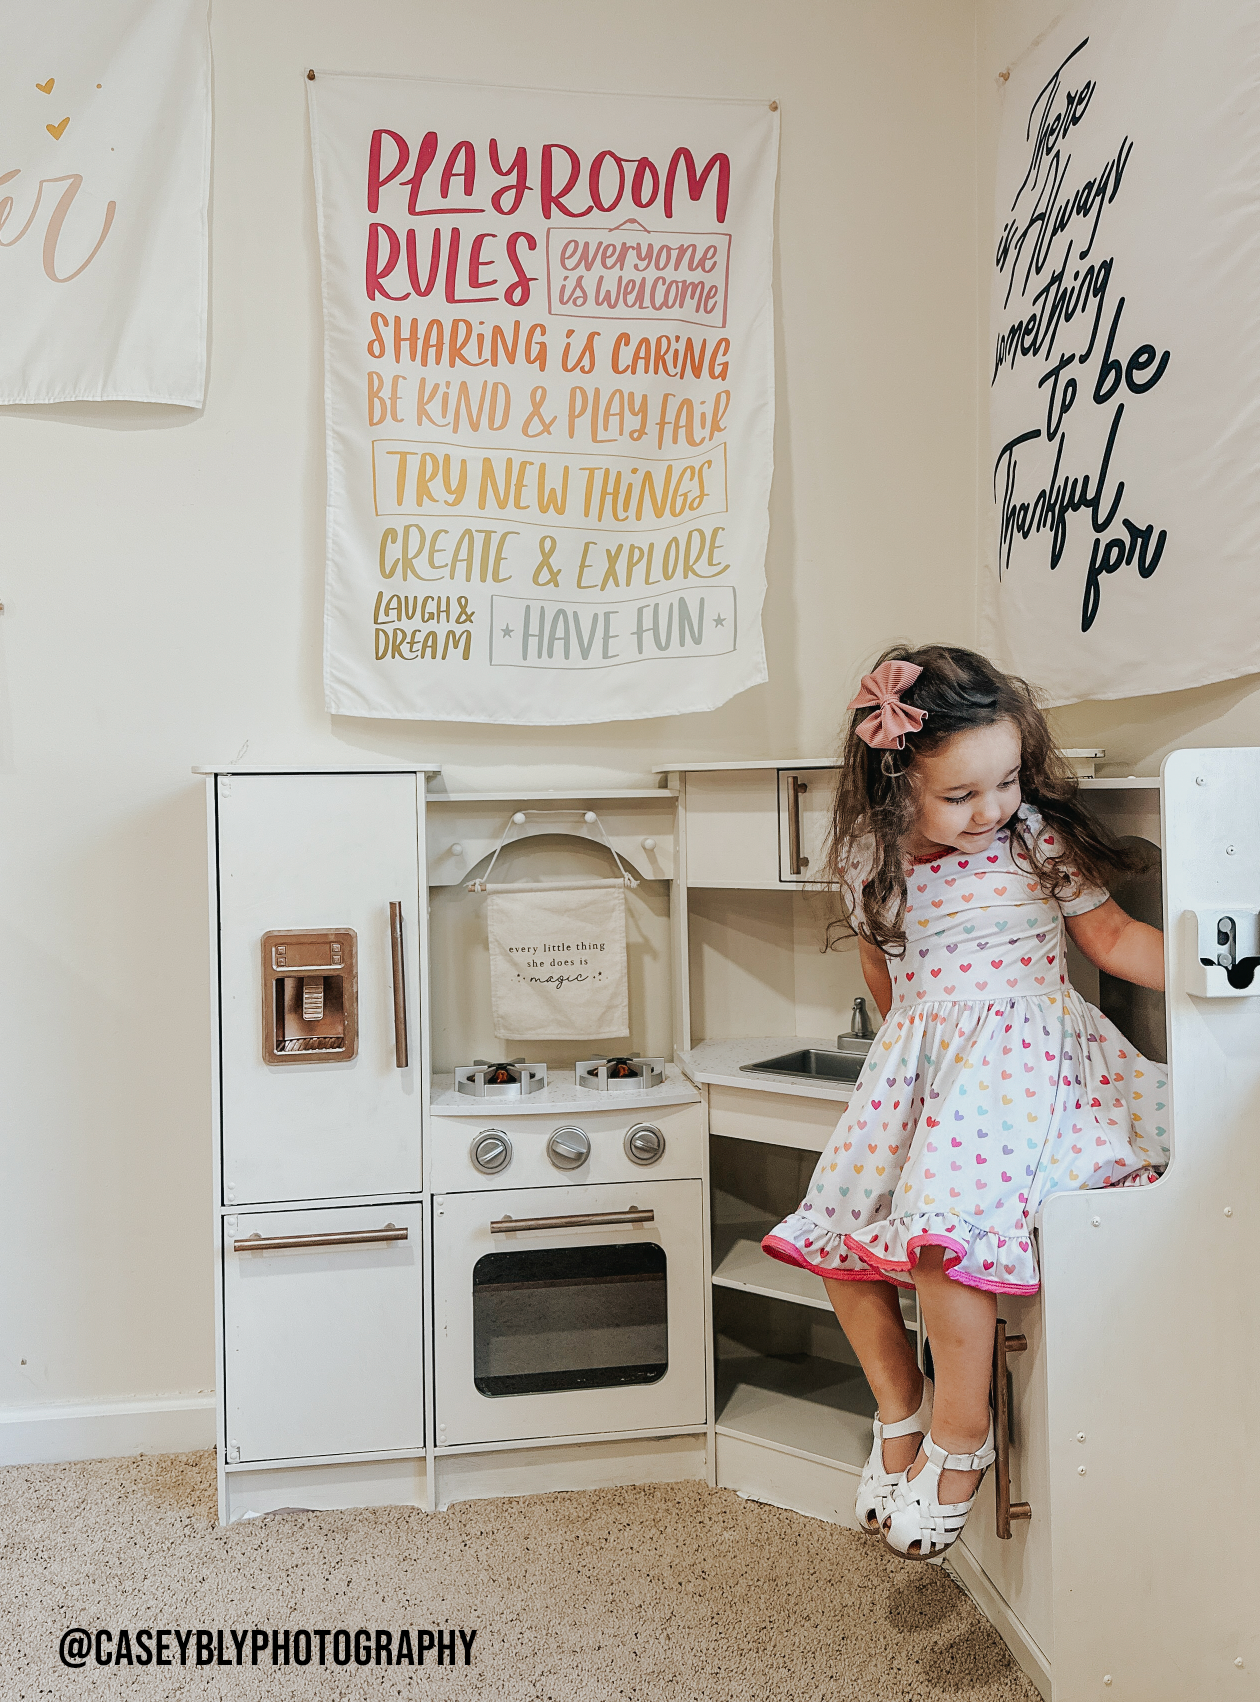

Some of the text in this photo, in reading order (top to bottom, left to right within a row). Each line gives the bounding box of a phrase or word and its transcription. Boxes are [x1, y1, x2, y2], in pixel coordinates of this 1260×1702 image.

[367, 129, 730, 223] PLAYROOM
[366, 223, 539, 306] RULES
[560, 239, 718, 273] everyone
[559, 275, 718, 314] is welcome
[1093, 297, 1171, 405] be
[367, 371, 408, 427] BE
[521, 385, 558, 439] &
[568, 386, 648, 443] PLAY
[386, 450, 468, 508] TRY
[478, 457, 570, 516] NEW
[379, 523, 731, 592] CREATE & EXPLORE
[1081, 518, 1167, 633] for
[456, 595, 476, 625] &
[521, 596, 705, 661] HAVE FUN
[374, 628, 472, 661] DREAM
[508, 941, 606, 955] every little thing
[526, 957, 589, 968] she does is
[529, 973, 589, 990] magic
